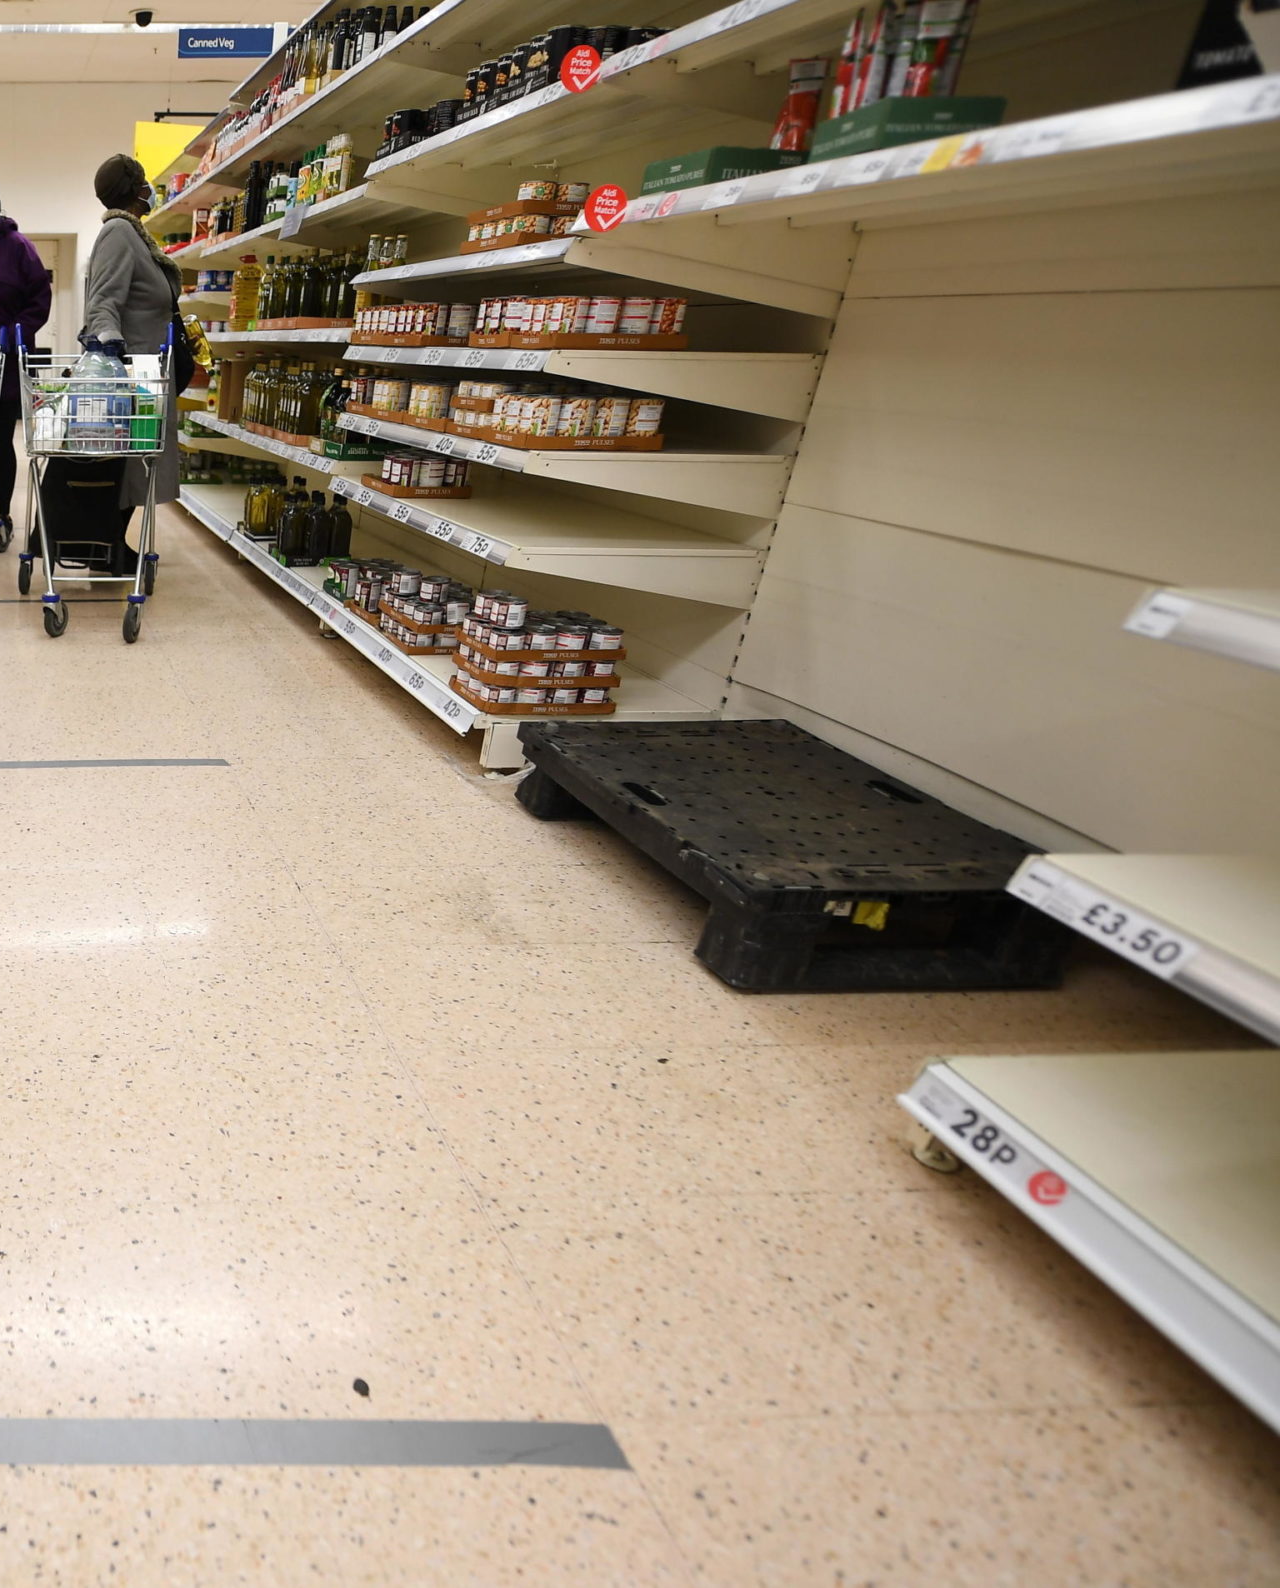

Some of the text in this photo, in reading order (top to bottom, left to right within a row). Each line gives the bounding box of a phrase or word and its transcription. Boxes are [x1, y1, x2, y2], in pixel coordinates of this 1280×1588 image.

[187, 37, 235, 49] Canned Veg
[575, 49, 590, 57] Aldi
[571, 57, 592, 67] Price
[569, 66, 592, 75] Match
[602, 189, 617, 197] Aldi
[596, 197, 619, 207] Price
[594, 205, 617, 215] Match
[515, 352, 538, 369] 65p
[435, 437, 454, 452] 40p
[476, 444, 497, 461] 55p
[394, 505, 409, 519] 55p
[434, 521, 453, 538] 55p
[470, 536, 489, 554] 75p
[378, 647, 393, 663] 40p
[408, 672, 424, 690] 65p
[443, 699, 461, 719] 42p
[1081, 903, 1183, 967] £3.50
[951, 1108, 1018, 1168] 28p
